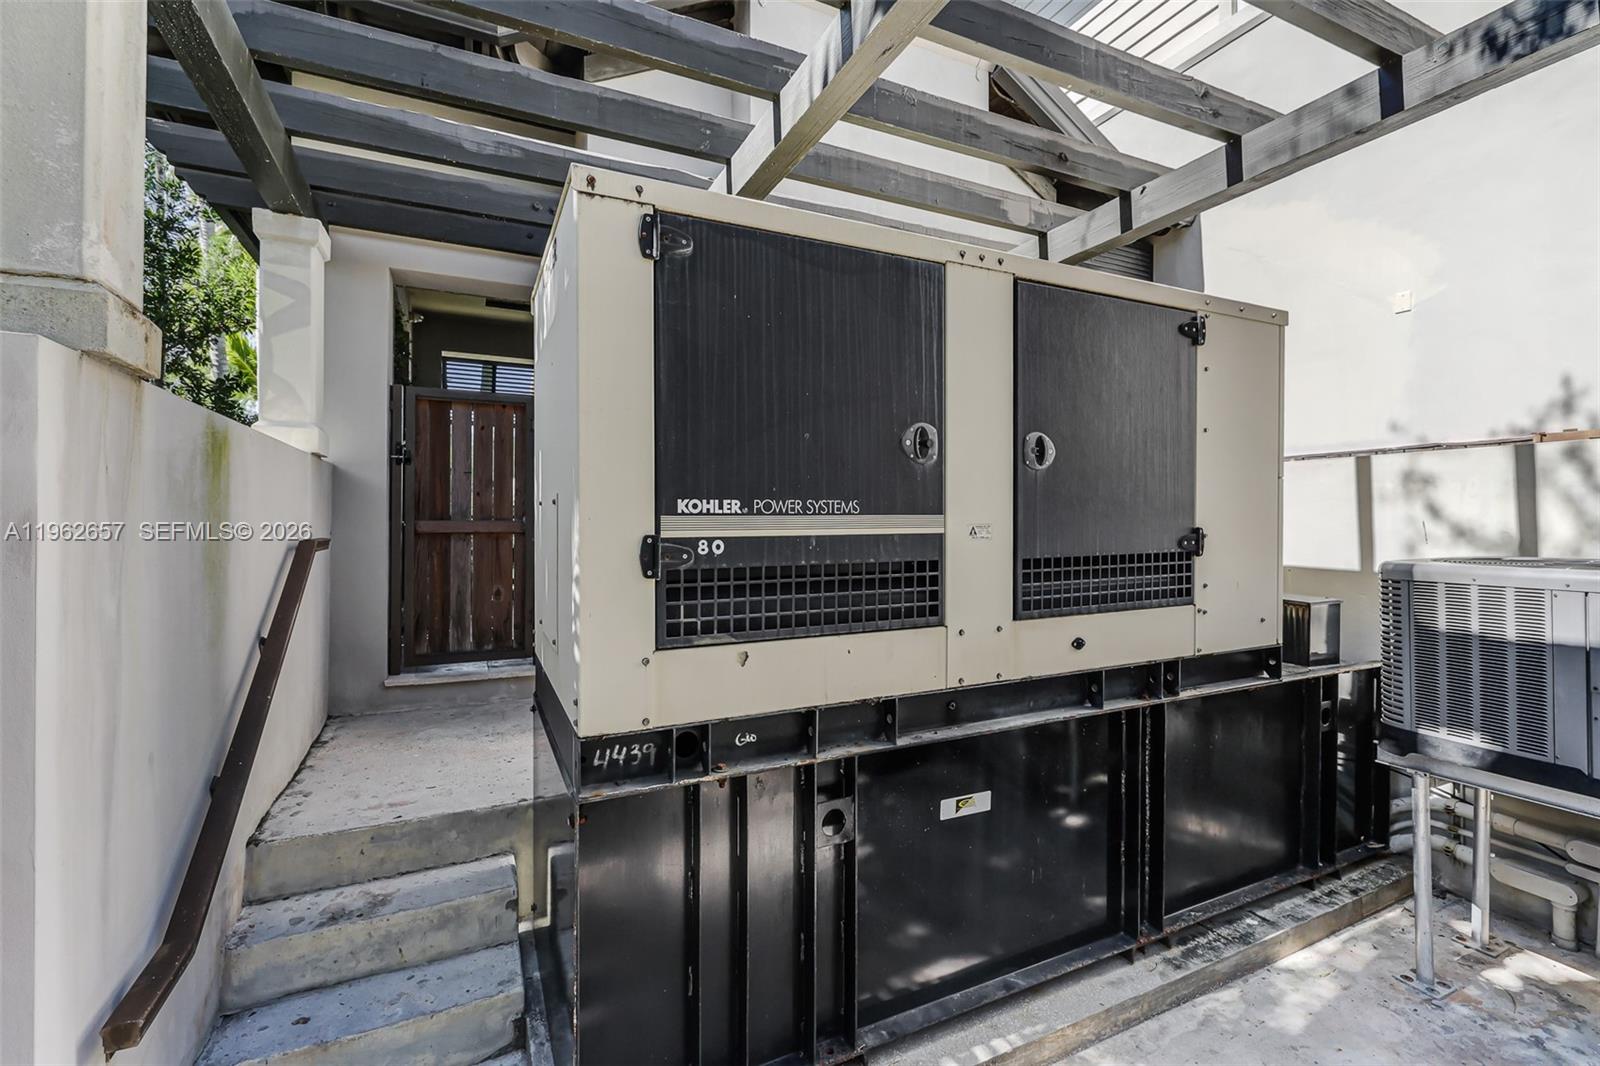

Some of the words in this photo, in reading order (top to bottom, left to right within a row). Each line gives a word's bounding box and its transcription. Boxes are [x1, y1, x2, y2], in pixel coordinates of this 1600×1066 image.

[677, 499, 743, 514] KOHLER
[753, 499, 803, 514] POWER
[806, 499, 860, 514] SYSTEMS
[697, 539, 725, 555] 80
[593, 742, 657, 769] 4439
